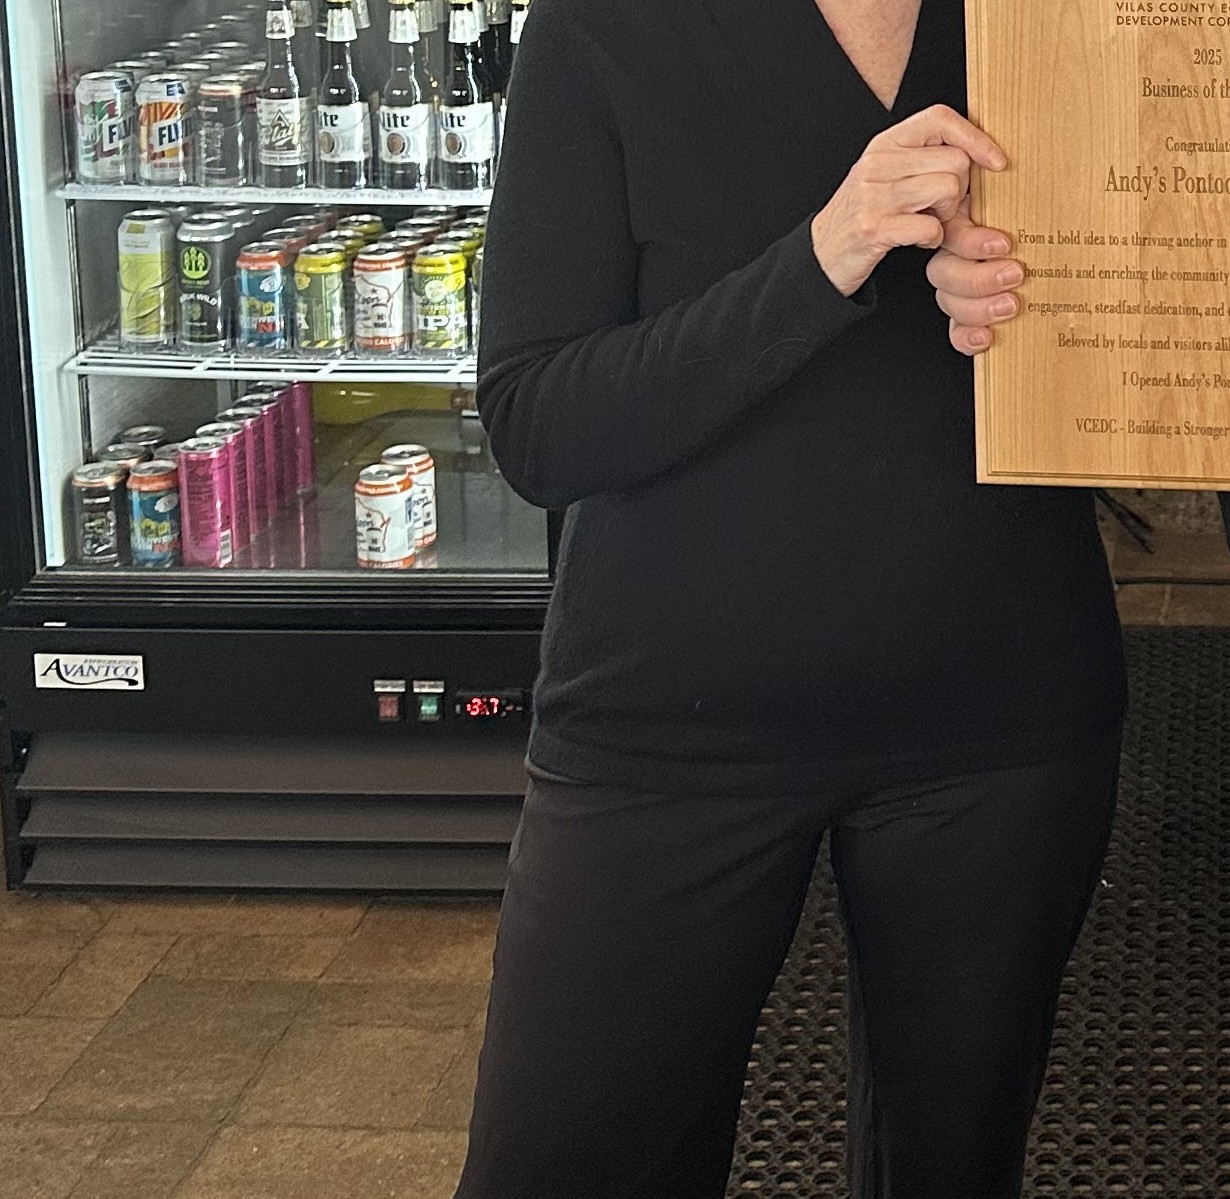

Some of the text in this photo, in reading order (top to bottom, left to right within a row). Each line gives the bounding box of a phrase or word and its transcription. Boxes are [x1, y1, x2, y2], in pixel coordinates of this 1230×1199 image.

[1116, 2, 1153, 13] VILAS
[1159, 3, 1214, 13] COUNTY
[1116, 15, 1204, 27] DEVELOPMENT
[1193, 48, 1223, 66] 2025
[1142, 76, 1199, 98] Business
[1202, 77, 1218, 99] of
[1104, 165, 1168, 200] Andy's
[1017, 229, 1045, 245] From
[1048, 235, 1055, 245] a
[1057, 230, 1081, 245] bold
[1084, 230, 1105, 246] idea
[1109, 233, 1119, 246] to
[1122, 236, 1128, 246] a
[1131, 231, 1174, 250] thriving
[1177, 233, 1214, 248] anchor
[1217, 234, 1227, 248] in
[1024, 263, 1073, 279] housands
[1076, 264, 1095, 279] and
[1099, 265, 1149, 284] enriching
[1151, 266, 1168, 281] the
[1170, 269, 1230, 286] community
[1122, 371, 1127, 386] I
[1130, 371, 1171, 390] Opened
[1174, 372, 1210, 393] Andy's
